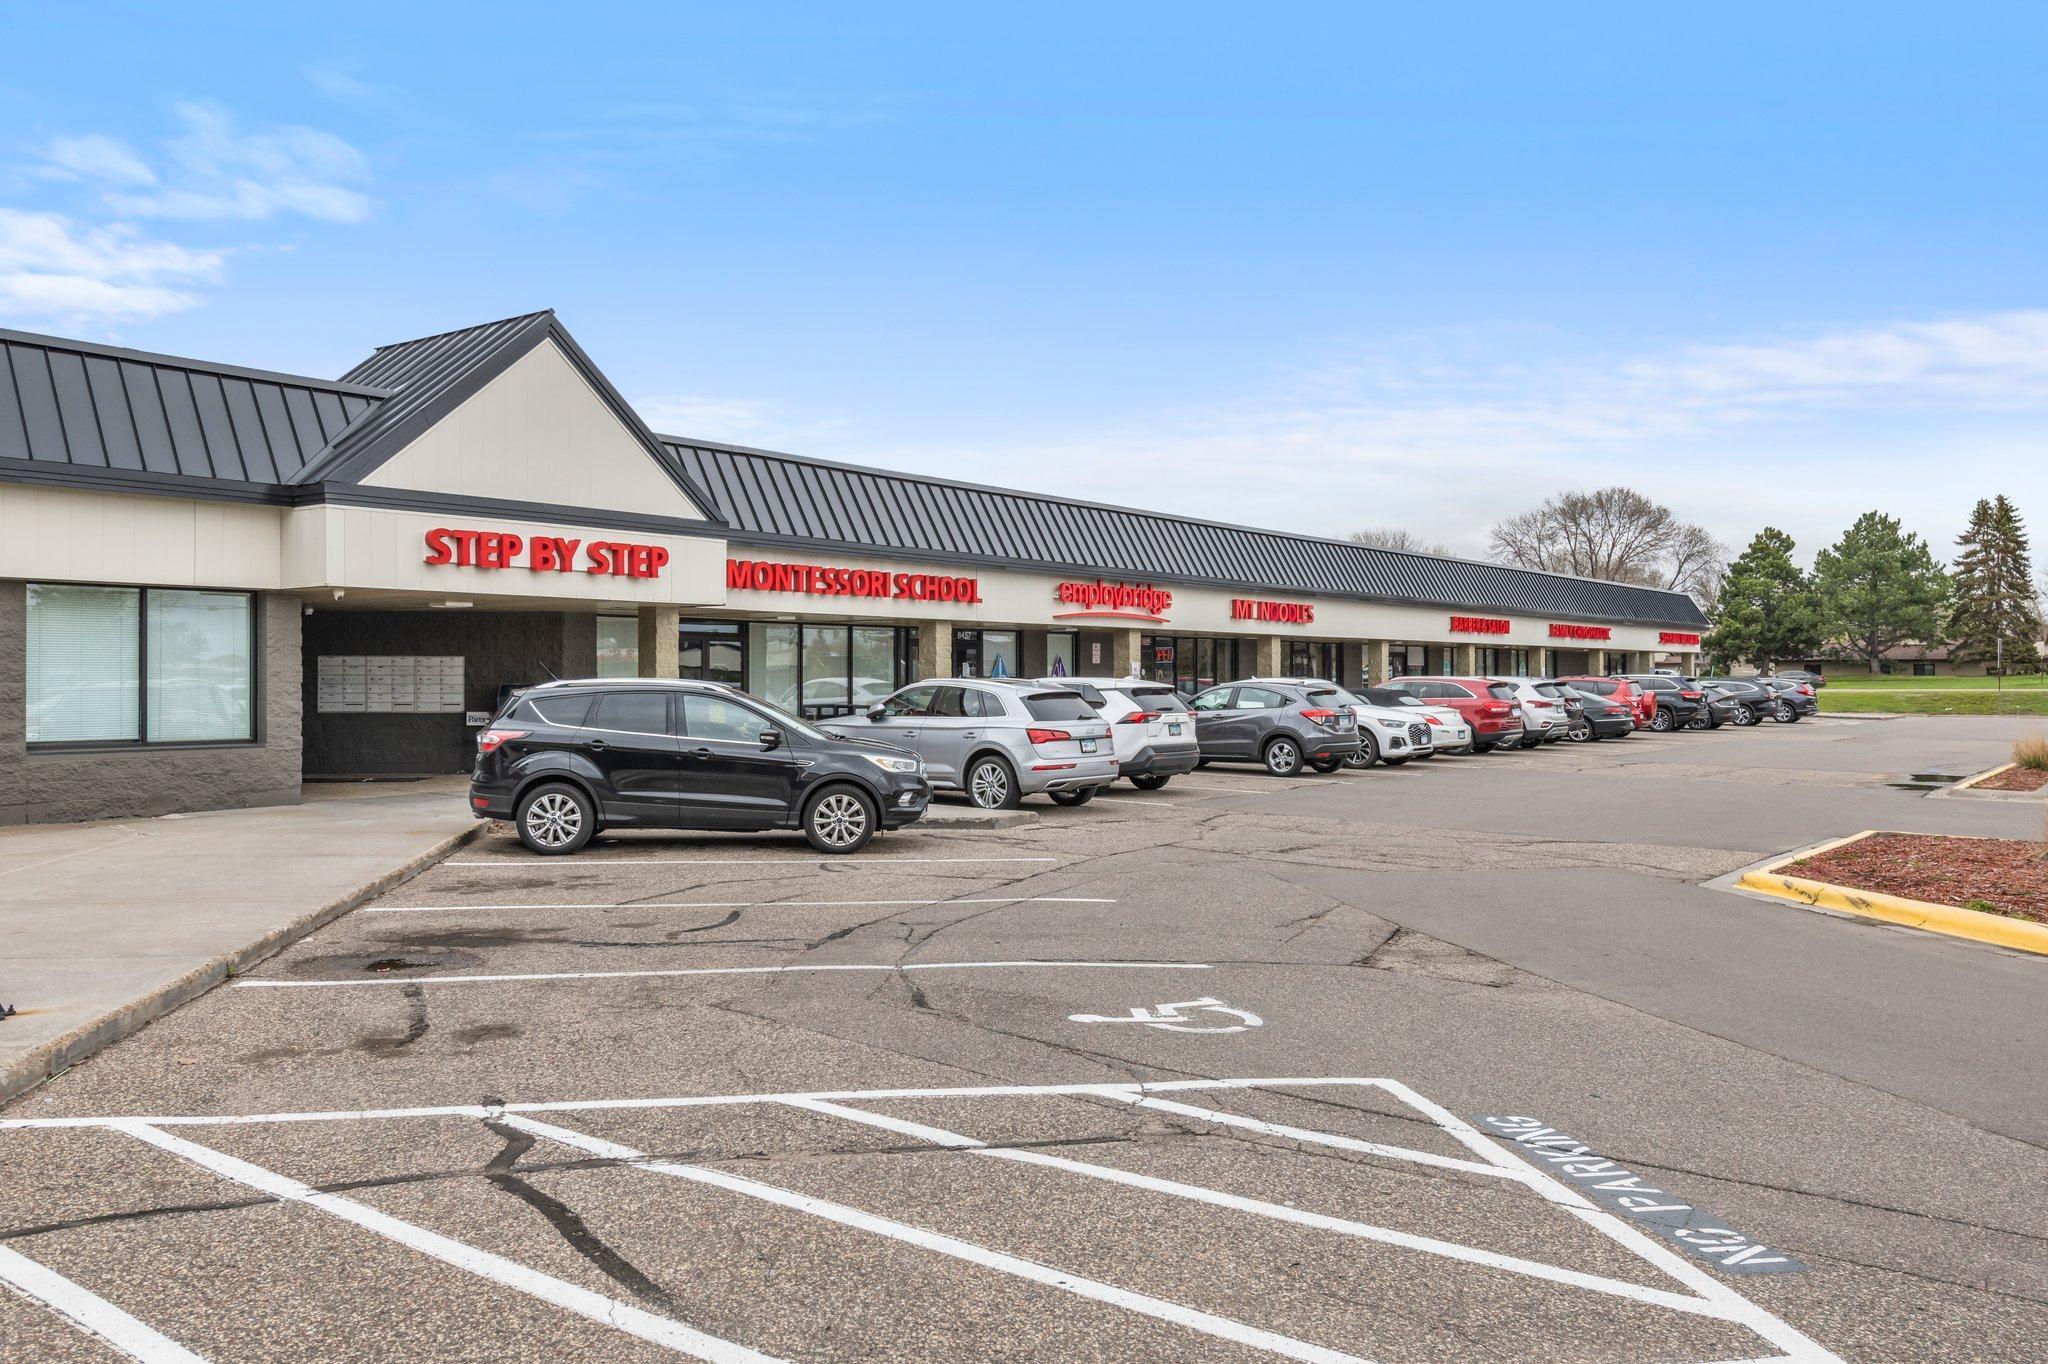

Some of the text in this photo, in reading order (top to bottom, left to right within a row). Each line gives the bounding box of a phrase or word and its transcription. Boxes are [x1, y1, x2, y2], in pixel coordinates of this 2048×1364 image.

[425, 528, 669, 578] STEP BY STEP
[726, 559, 982, 604] MONTESSORI SCHOOL
[1058, 579, 1173, 615] employbridge
[1257, 601, 1315, 624] NOODLES
[1450, 616, 1481, 633] BARBER
[957, 631, 972, 640] 8457
[1486, 1116, 1788, 1265] NO PARKING
